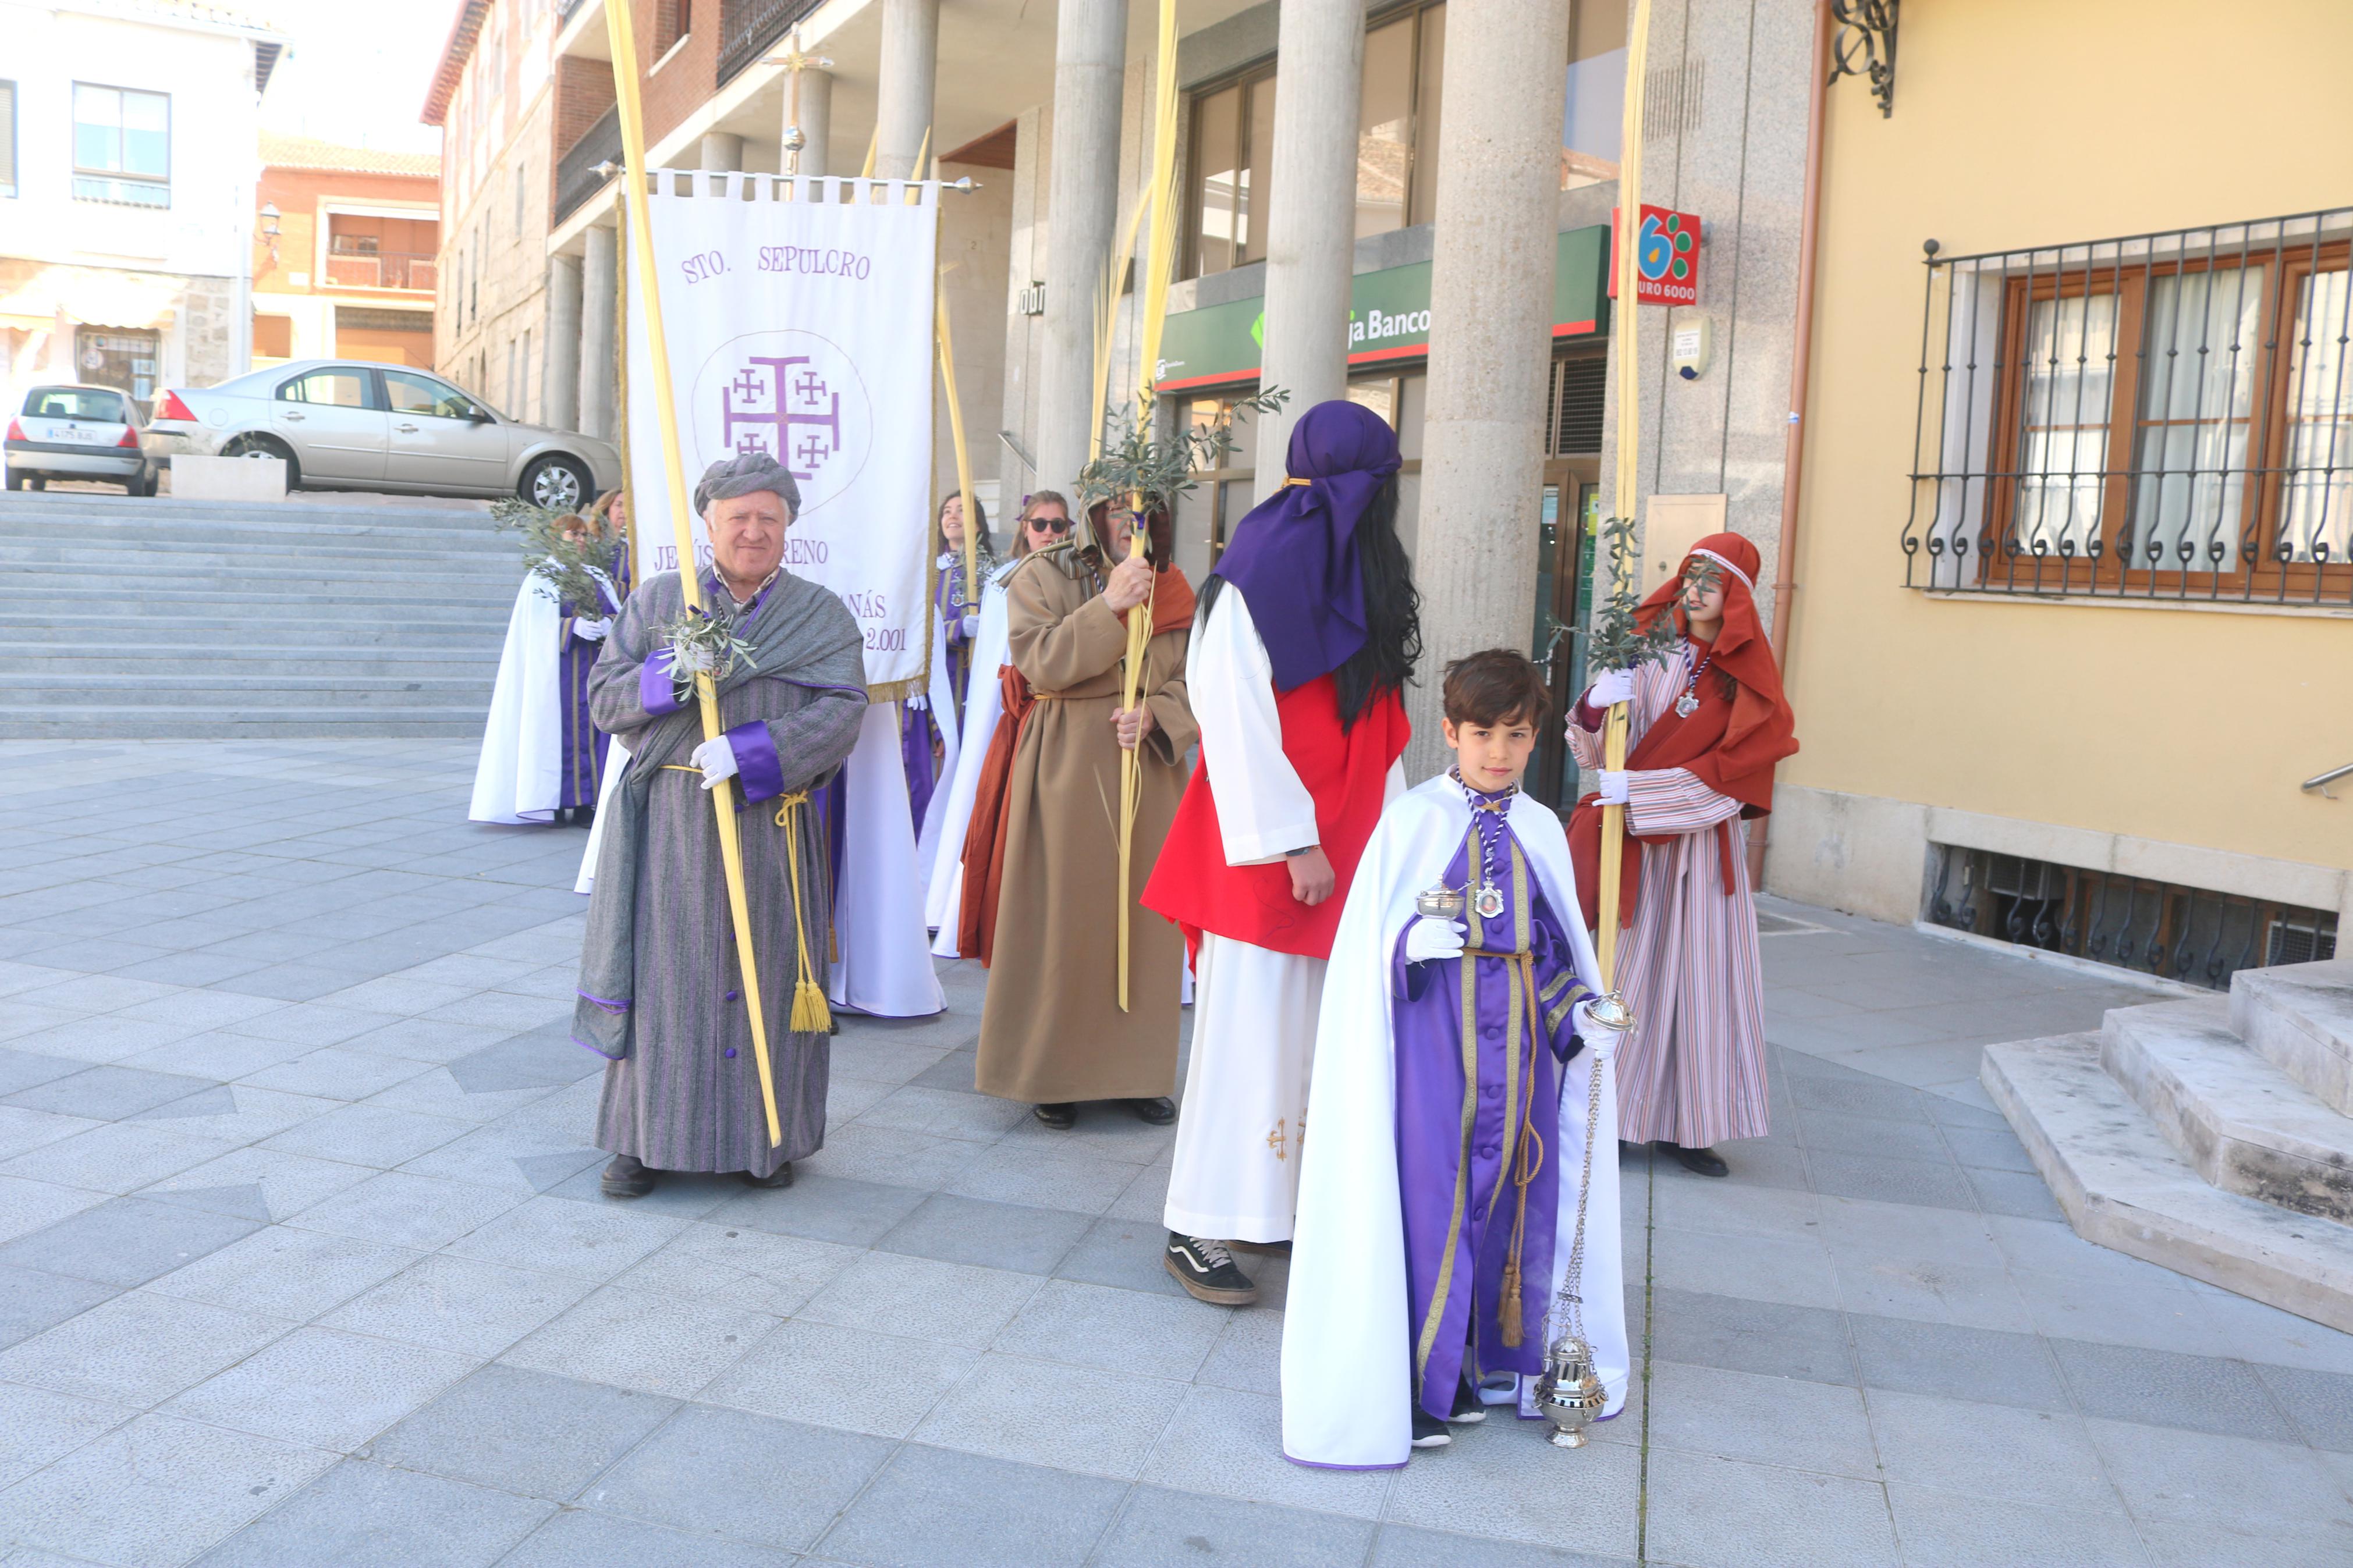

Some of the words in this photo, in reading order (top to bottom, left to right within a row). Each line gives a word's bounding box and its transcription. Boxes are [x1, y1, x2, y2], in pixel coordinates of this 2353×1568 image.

[681, 250, 731, 285] STO.
[758, 246, 870, 280] SEPULCRO
[1638, 281, 1662, 296] URO
[1663, 285, 1695, 300] 6000
[1368, 309, 1431, 340] Banco
[654, 538, 714, 571] JEÚS
[780, 538, 828, 565] RENO
[865, 627, 907, 651] 2.001
